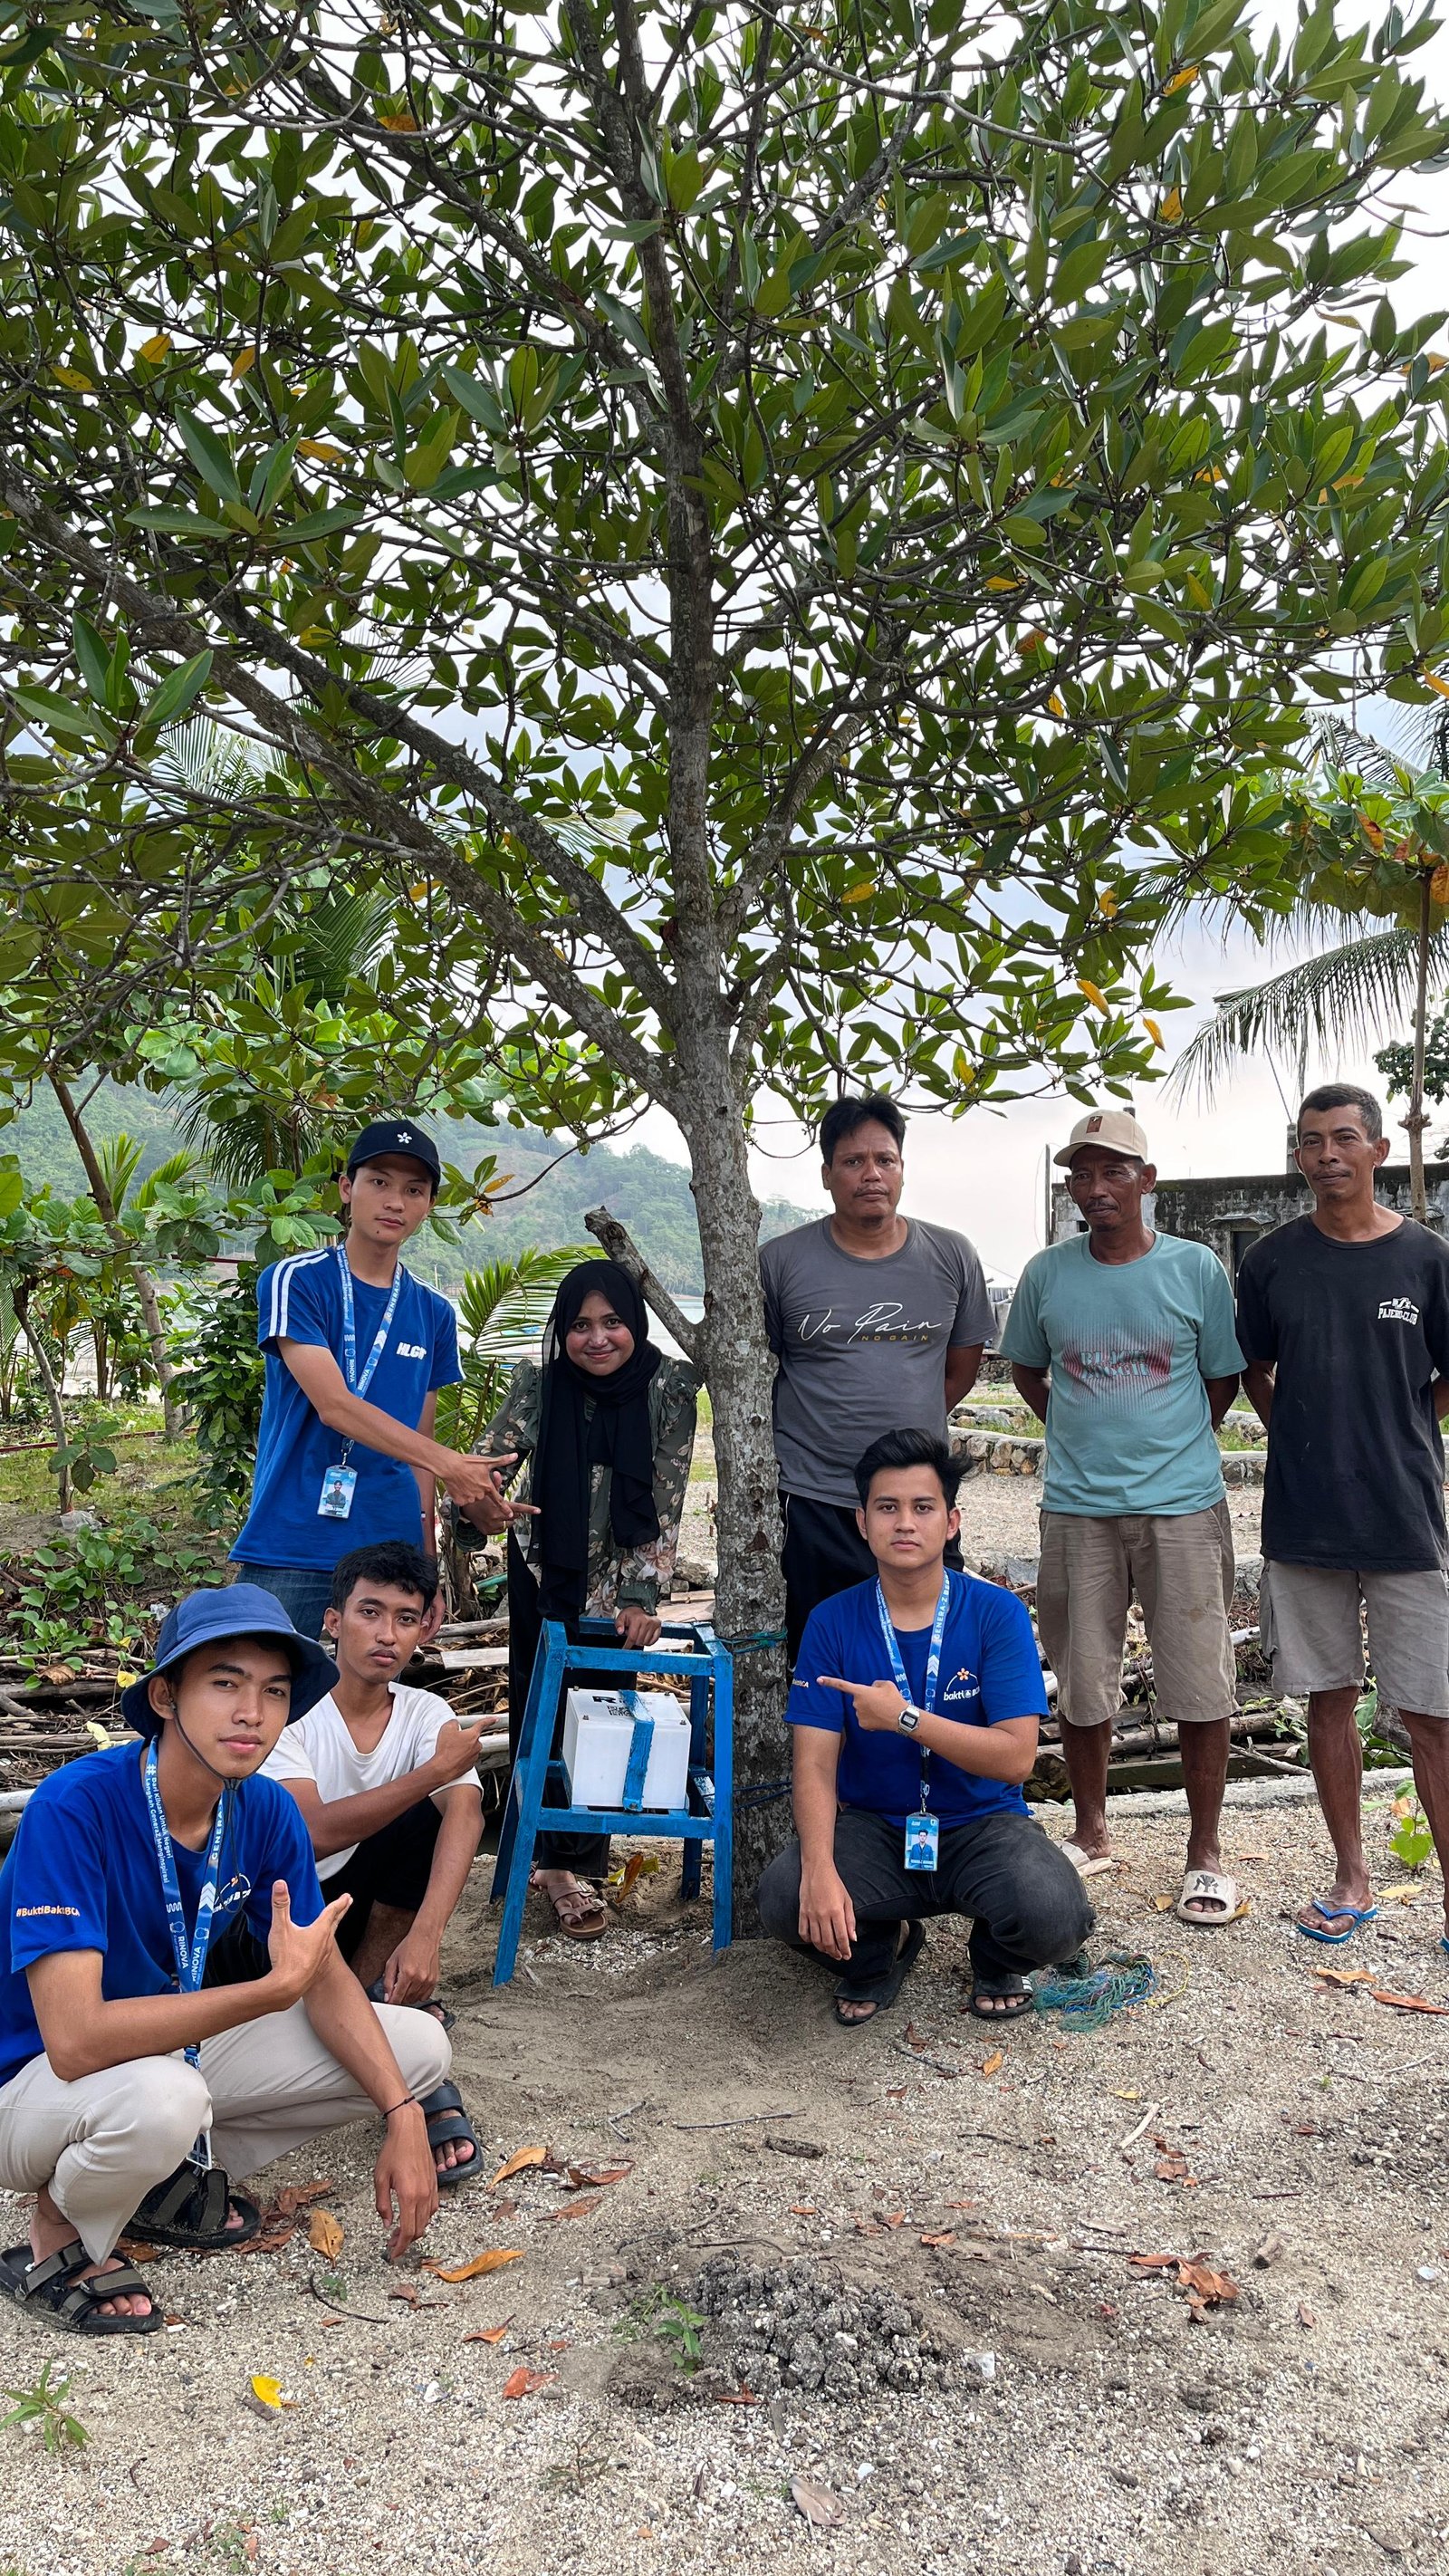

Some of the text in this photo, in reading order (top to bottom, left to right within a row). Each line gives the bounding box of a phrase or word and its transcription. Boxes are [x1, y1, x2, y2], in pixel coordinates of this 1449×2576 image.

[798, 1302, 942, 1344] No Pain
[145, 1778, 154, 1811] Langkah
[178, 1936, 189, 1969] RINOVA
